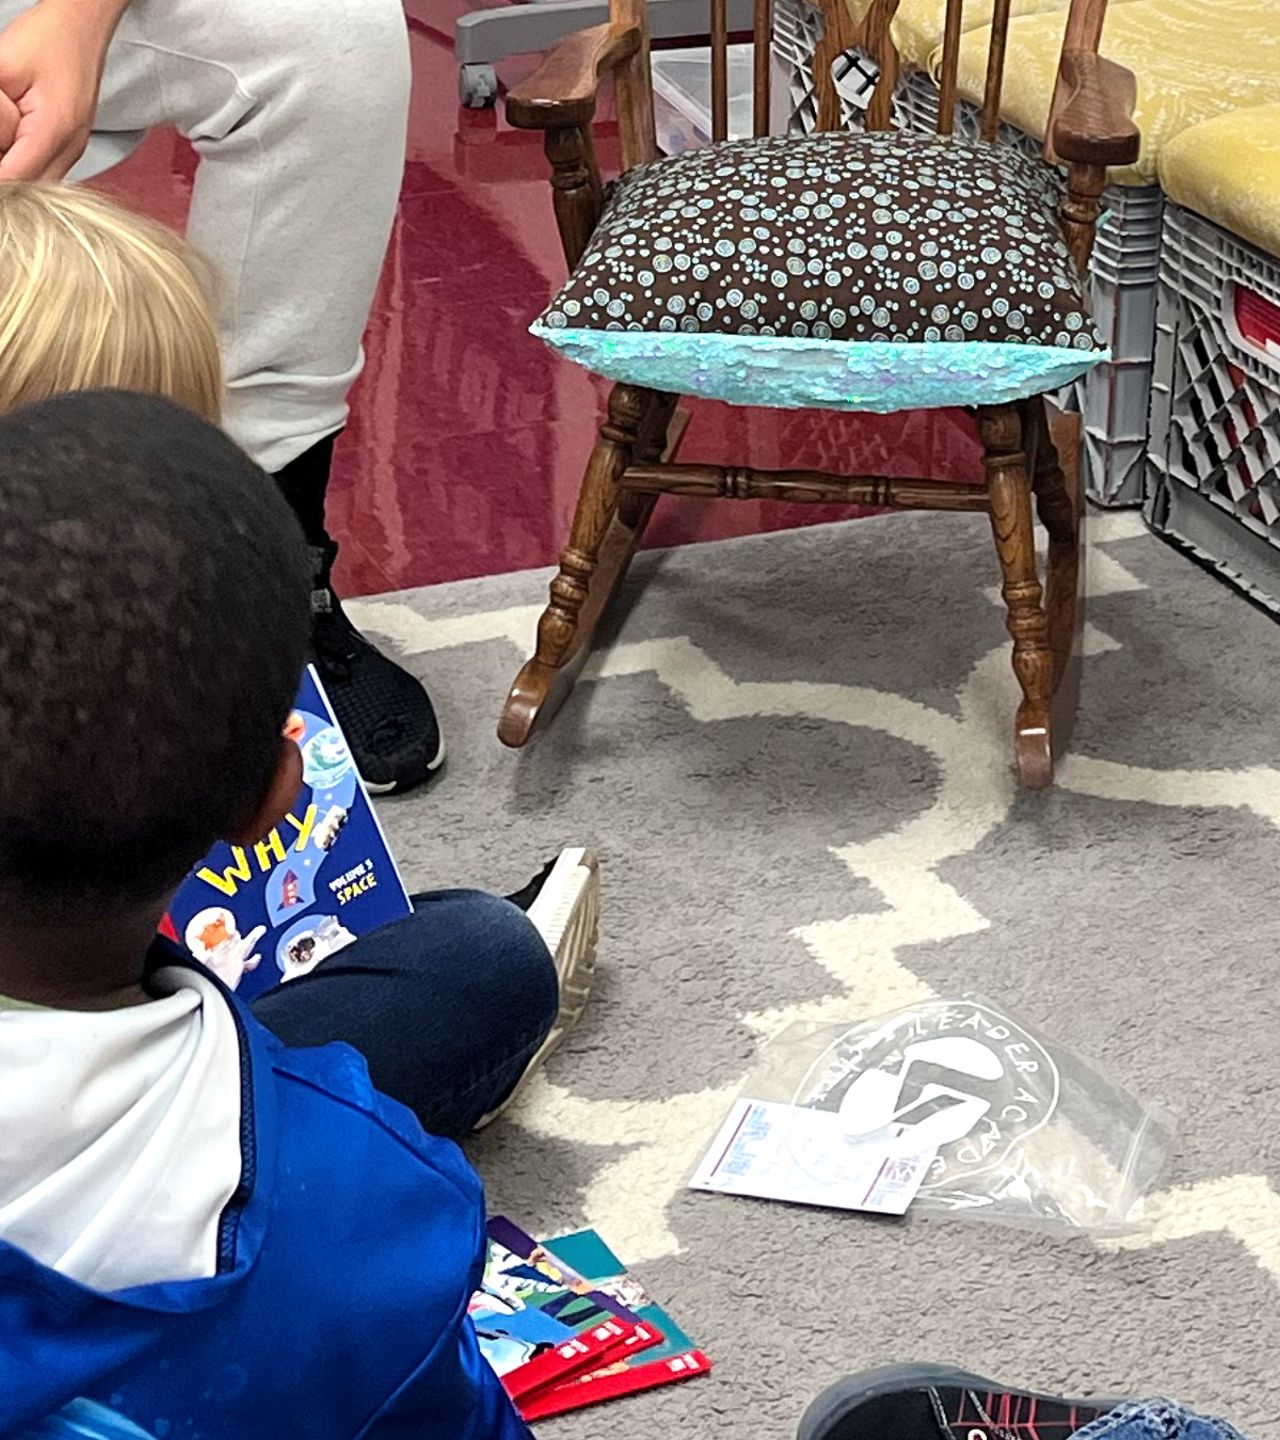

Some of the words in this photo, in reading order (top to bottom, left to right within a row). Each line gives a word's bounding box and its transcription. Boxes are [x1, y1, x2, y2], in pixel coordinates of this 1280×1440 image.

[196, 803, 318, 897] WHY
[329, 864, 366, 893] VOLUME
[336, 871, 377, 906] SPACE
